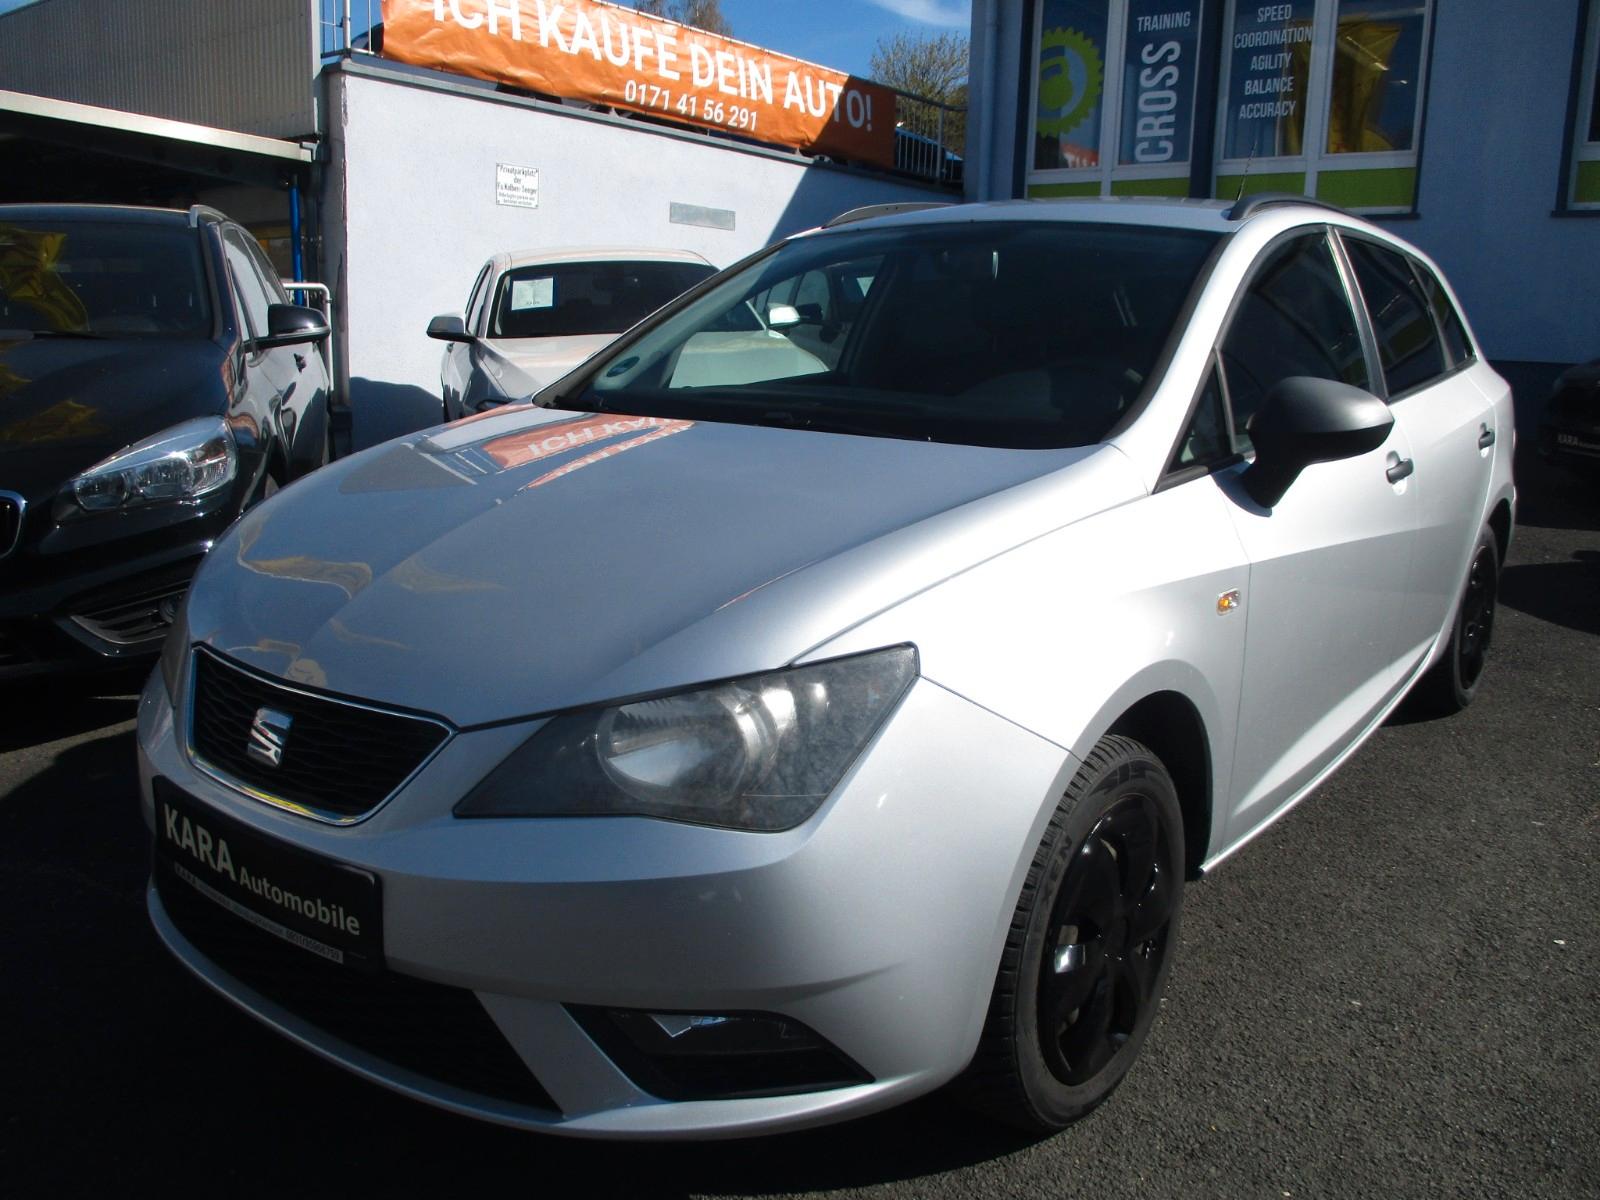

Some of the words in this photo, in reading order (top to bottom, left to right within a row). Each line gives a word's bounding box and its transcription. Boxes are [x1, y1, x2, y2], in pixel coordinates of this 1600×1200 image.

[1137, 11, 1191, 33] TRAINING
[1257, 4, 1292, 23] SPEED
[1234, 26, 1314, 49] COORDINATION
[535, 0, 680, 81] KAUFE
[690, 43, 773, 105] DEIN
[783, 71, 872, 132] AUTO!
[1250, 52, 1293, 71] AGILITY
[1244, 76, 1294, 96] BALANCE
[624, 79, 670, 111] 0171
[676, 93, 697, 117] 41
[703, 99, 724, 124] 56
[727, 105, 757, 131] 291
[1134, 40, 1181, 163] CROSS
[1239, 101, 1296, 120] ACCURACY
[164, 803, 237, 882] KARA
[239, 867, 361, 936] Automobile
